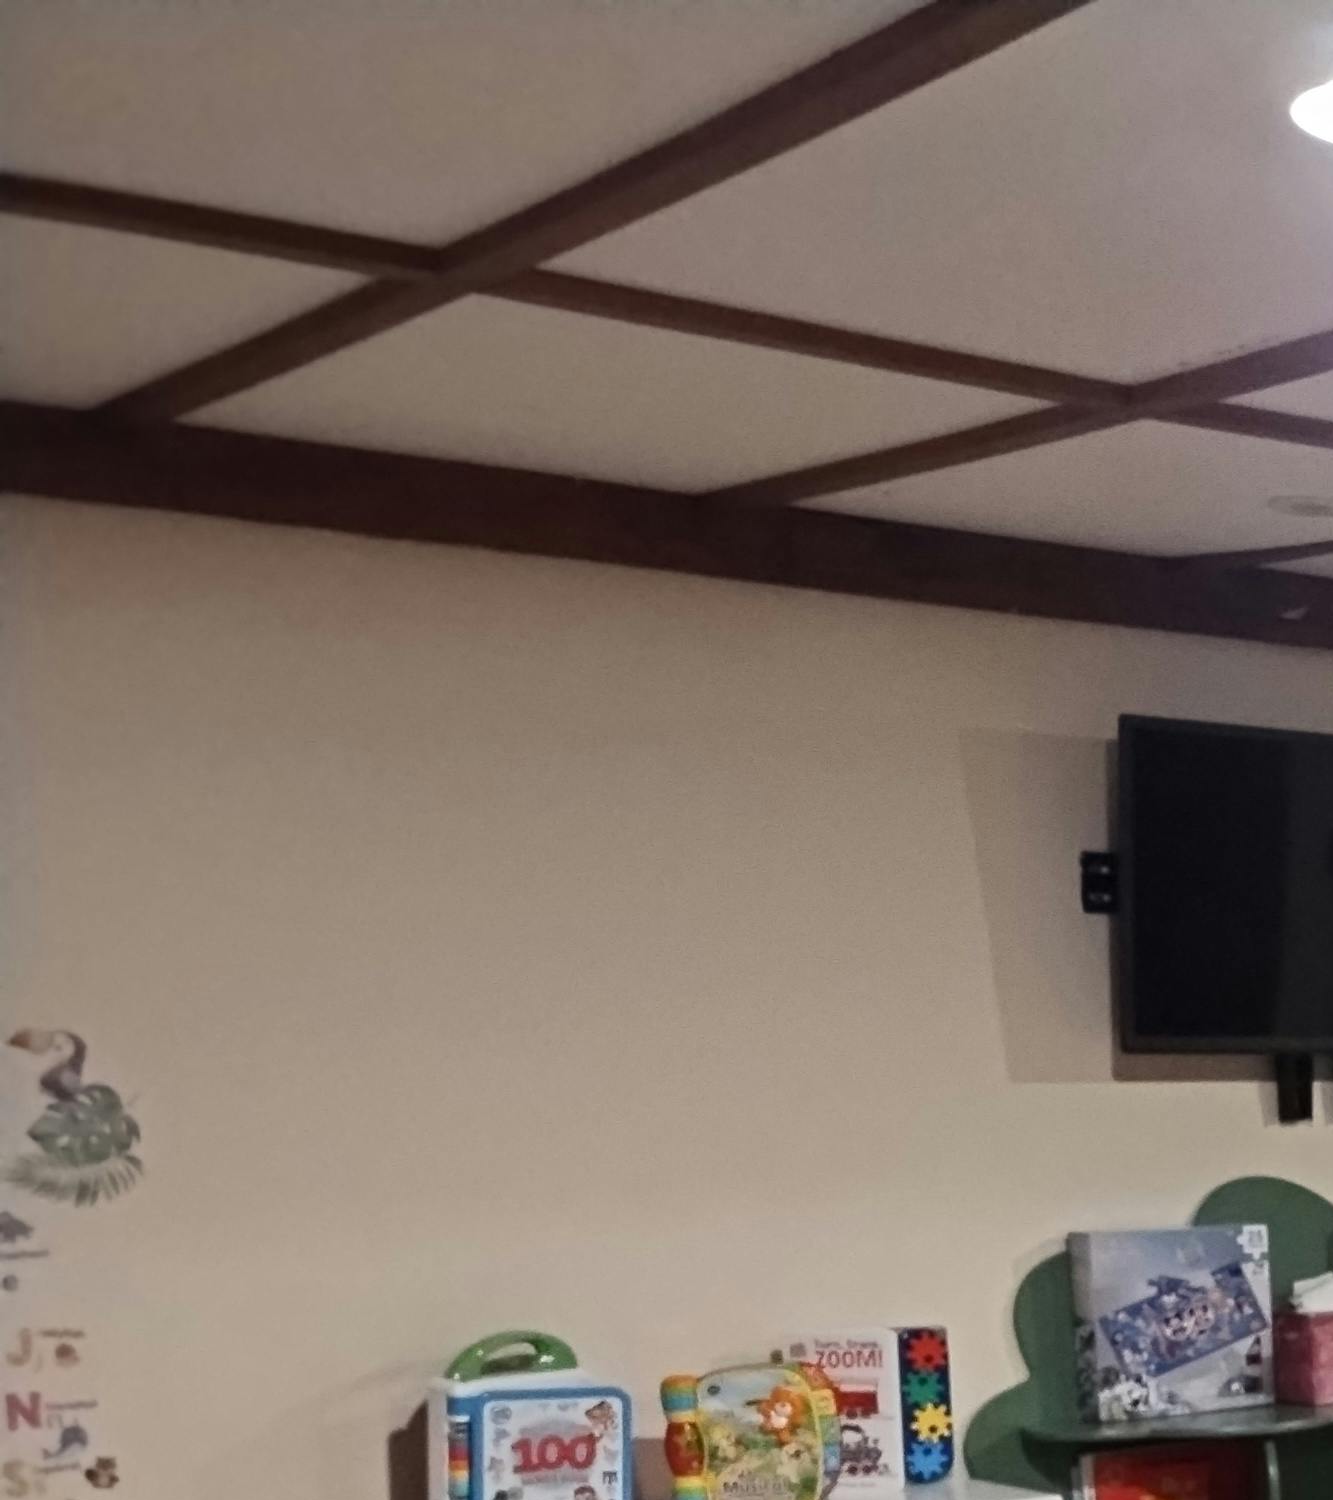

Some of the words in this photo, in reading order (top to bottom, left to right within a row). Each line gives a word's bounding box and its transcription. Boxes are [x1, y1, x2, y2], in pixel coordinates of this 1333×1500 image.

[815, 1349, 884, 1368] ZOOM!
[5, 1391, 42, 1431] N
[512, 1432, 597, 1475] 100
